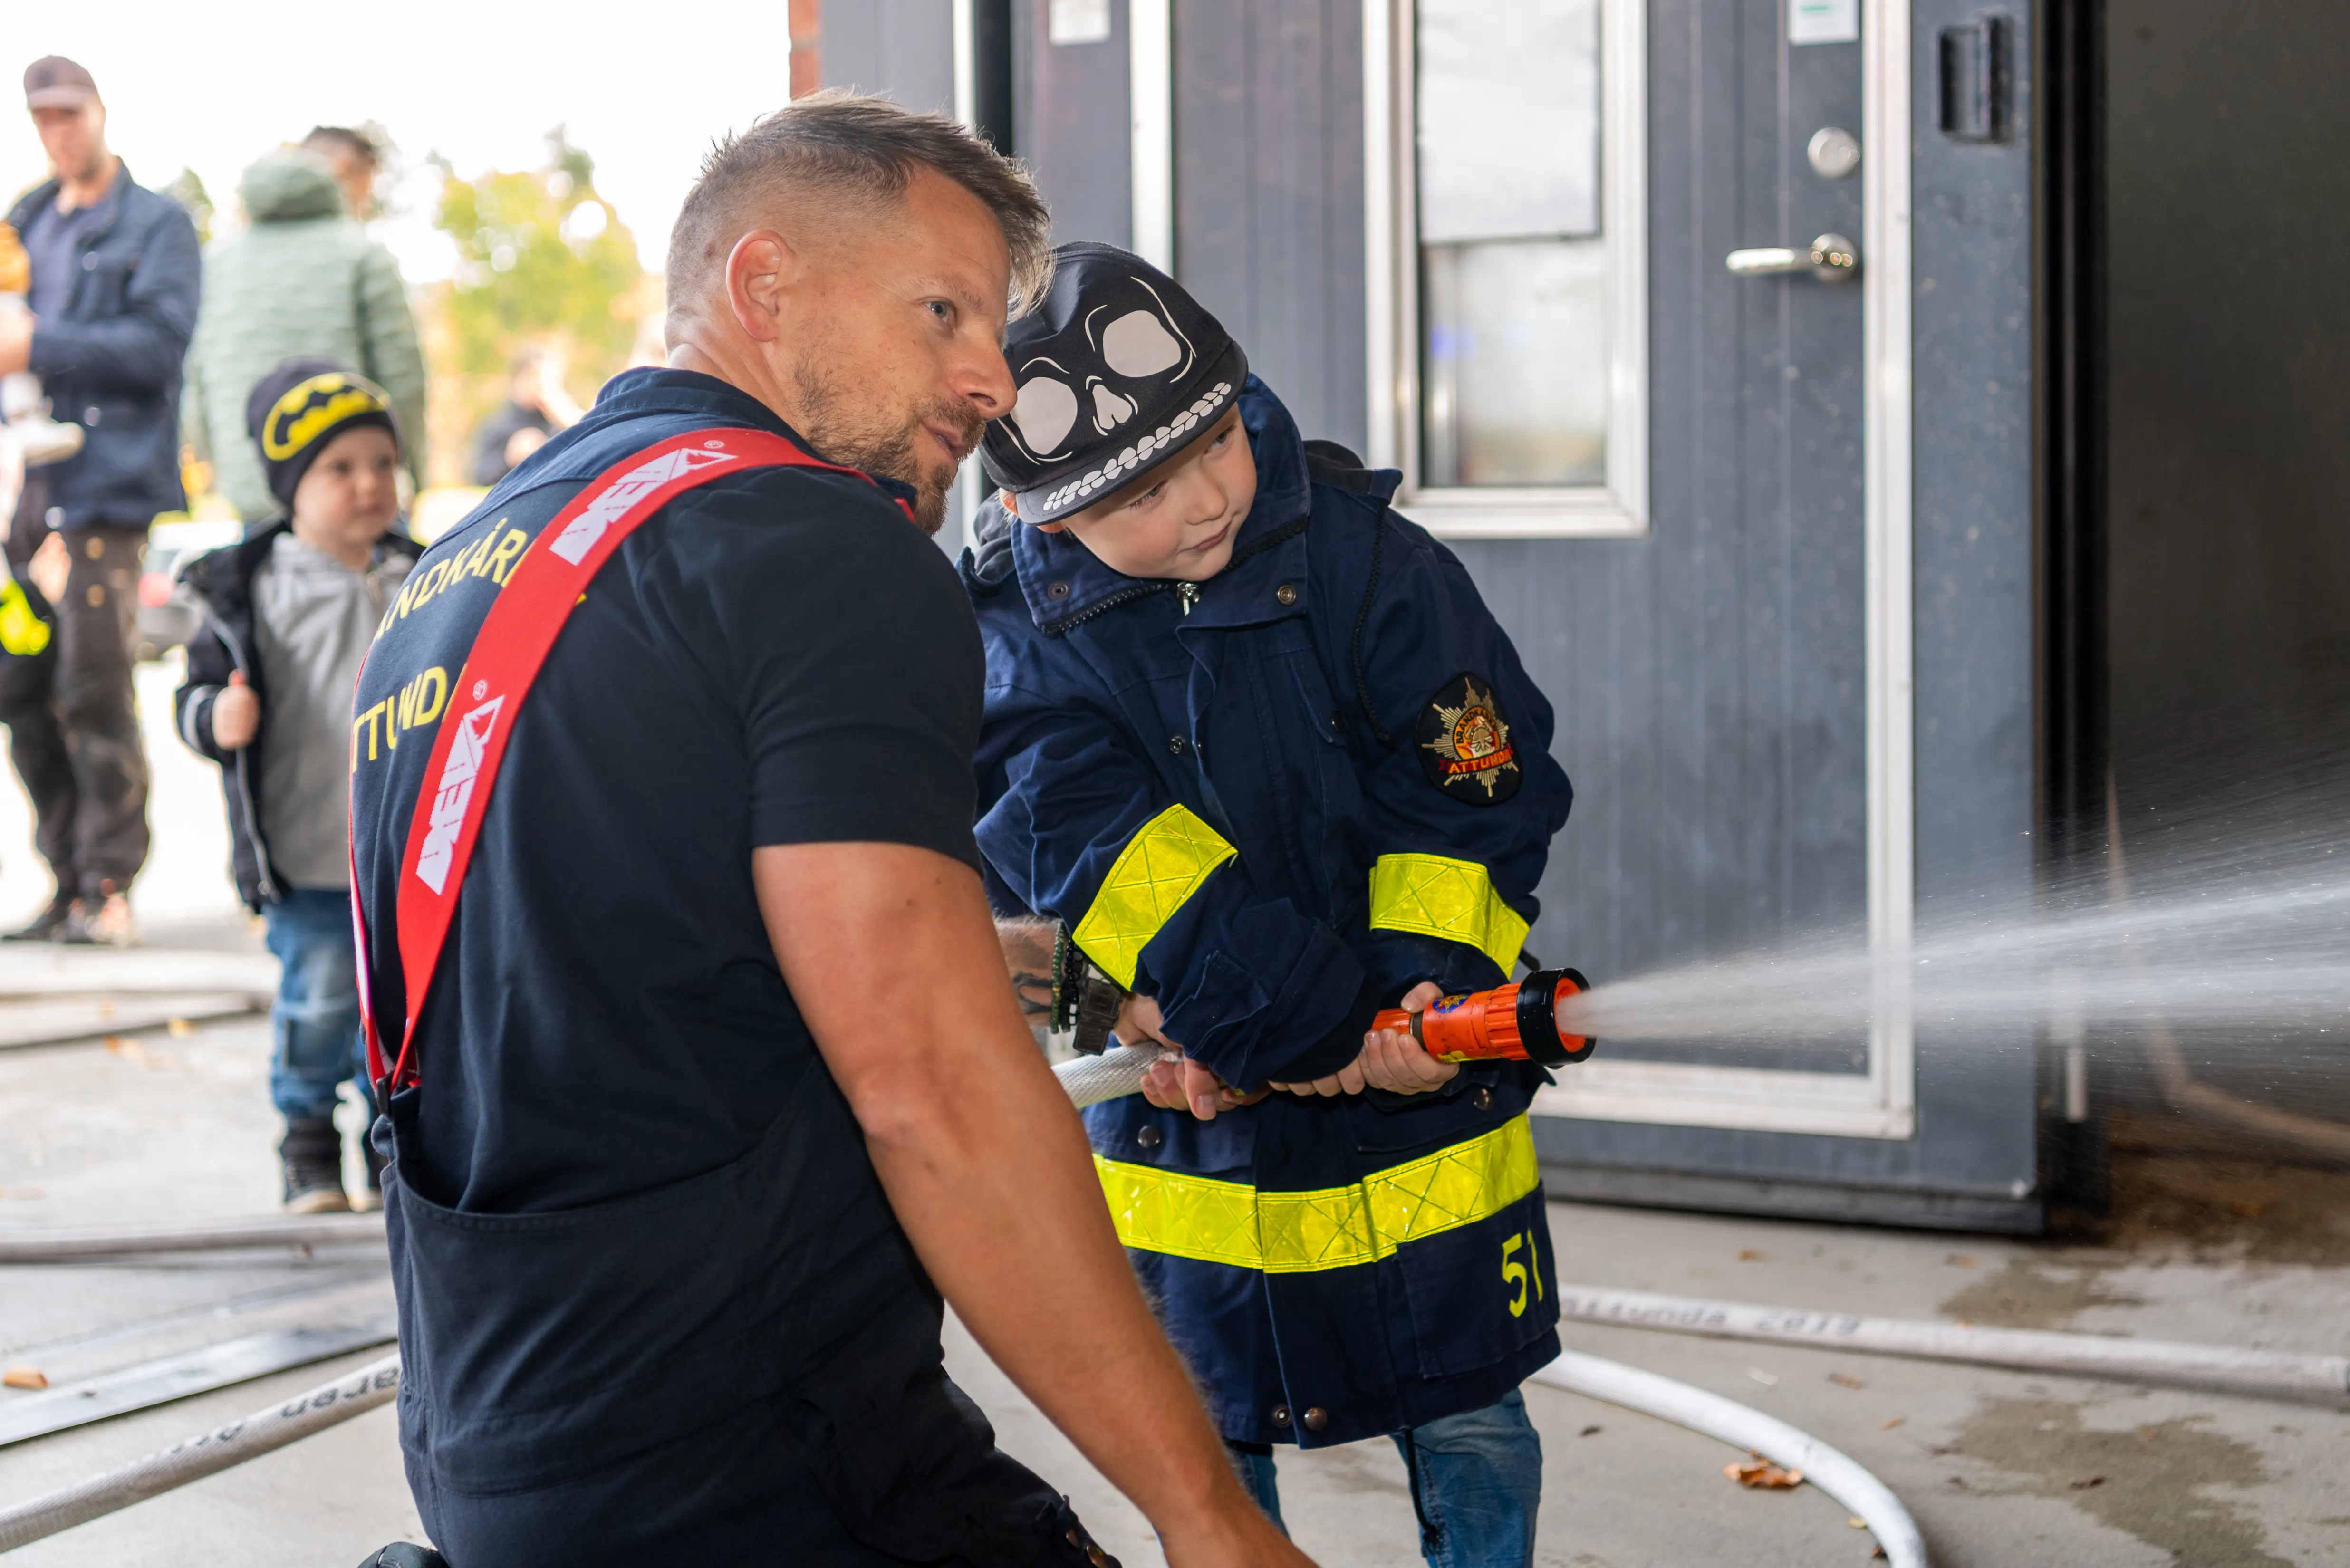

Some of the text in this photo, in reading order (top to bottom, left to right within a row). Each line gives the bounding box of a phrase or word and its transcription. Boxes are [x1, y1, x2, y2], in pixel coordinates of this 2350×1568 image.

[373, 518, 527, 639] NDKÅR
[353, 666, 467, 773] TTUND
[1502, 1228, 1543, 1318] 51
